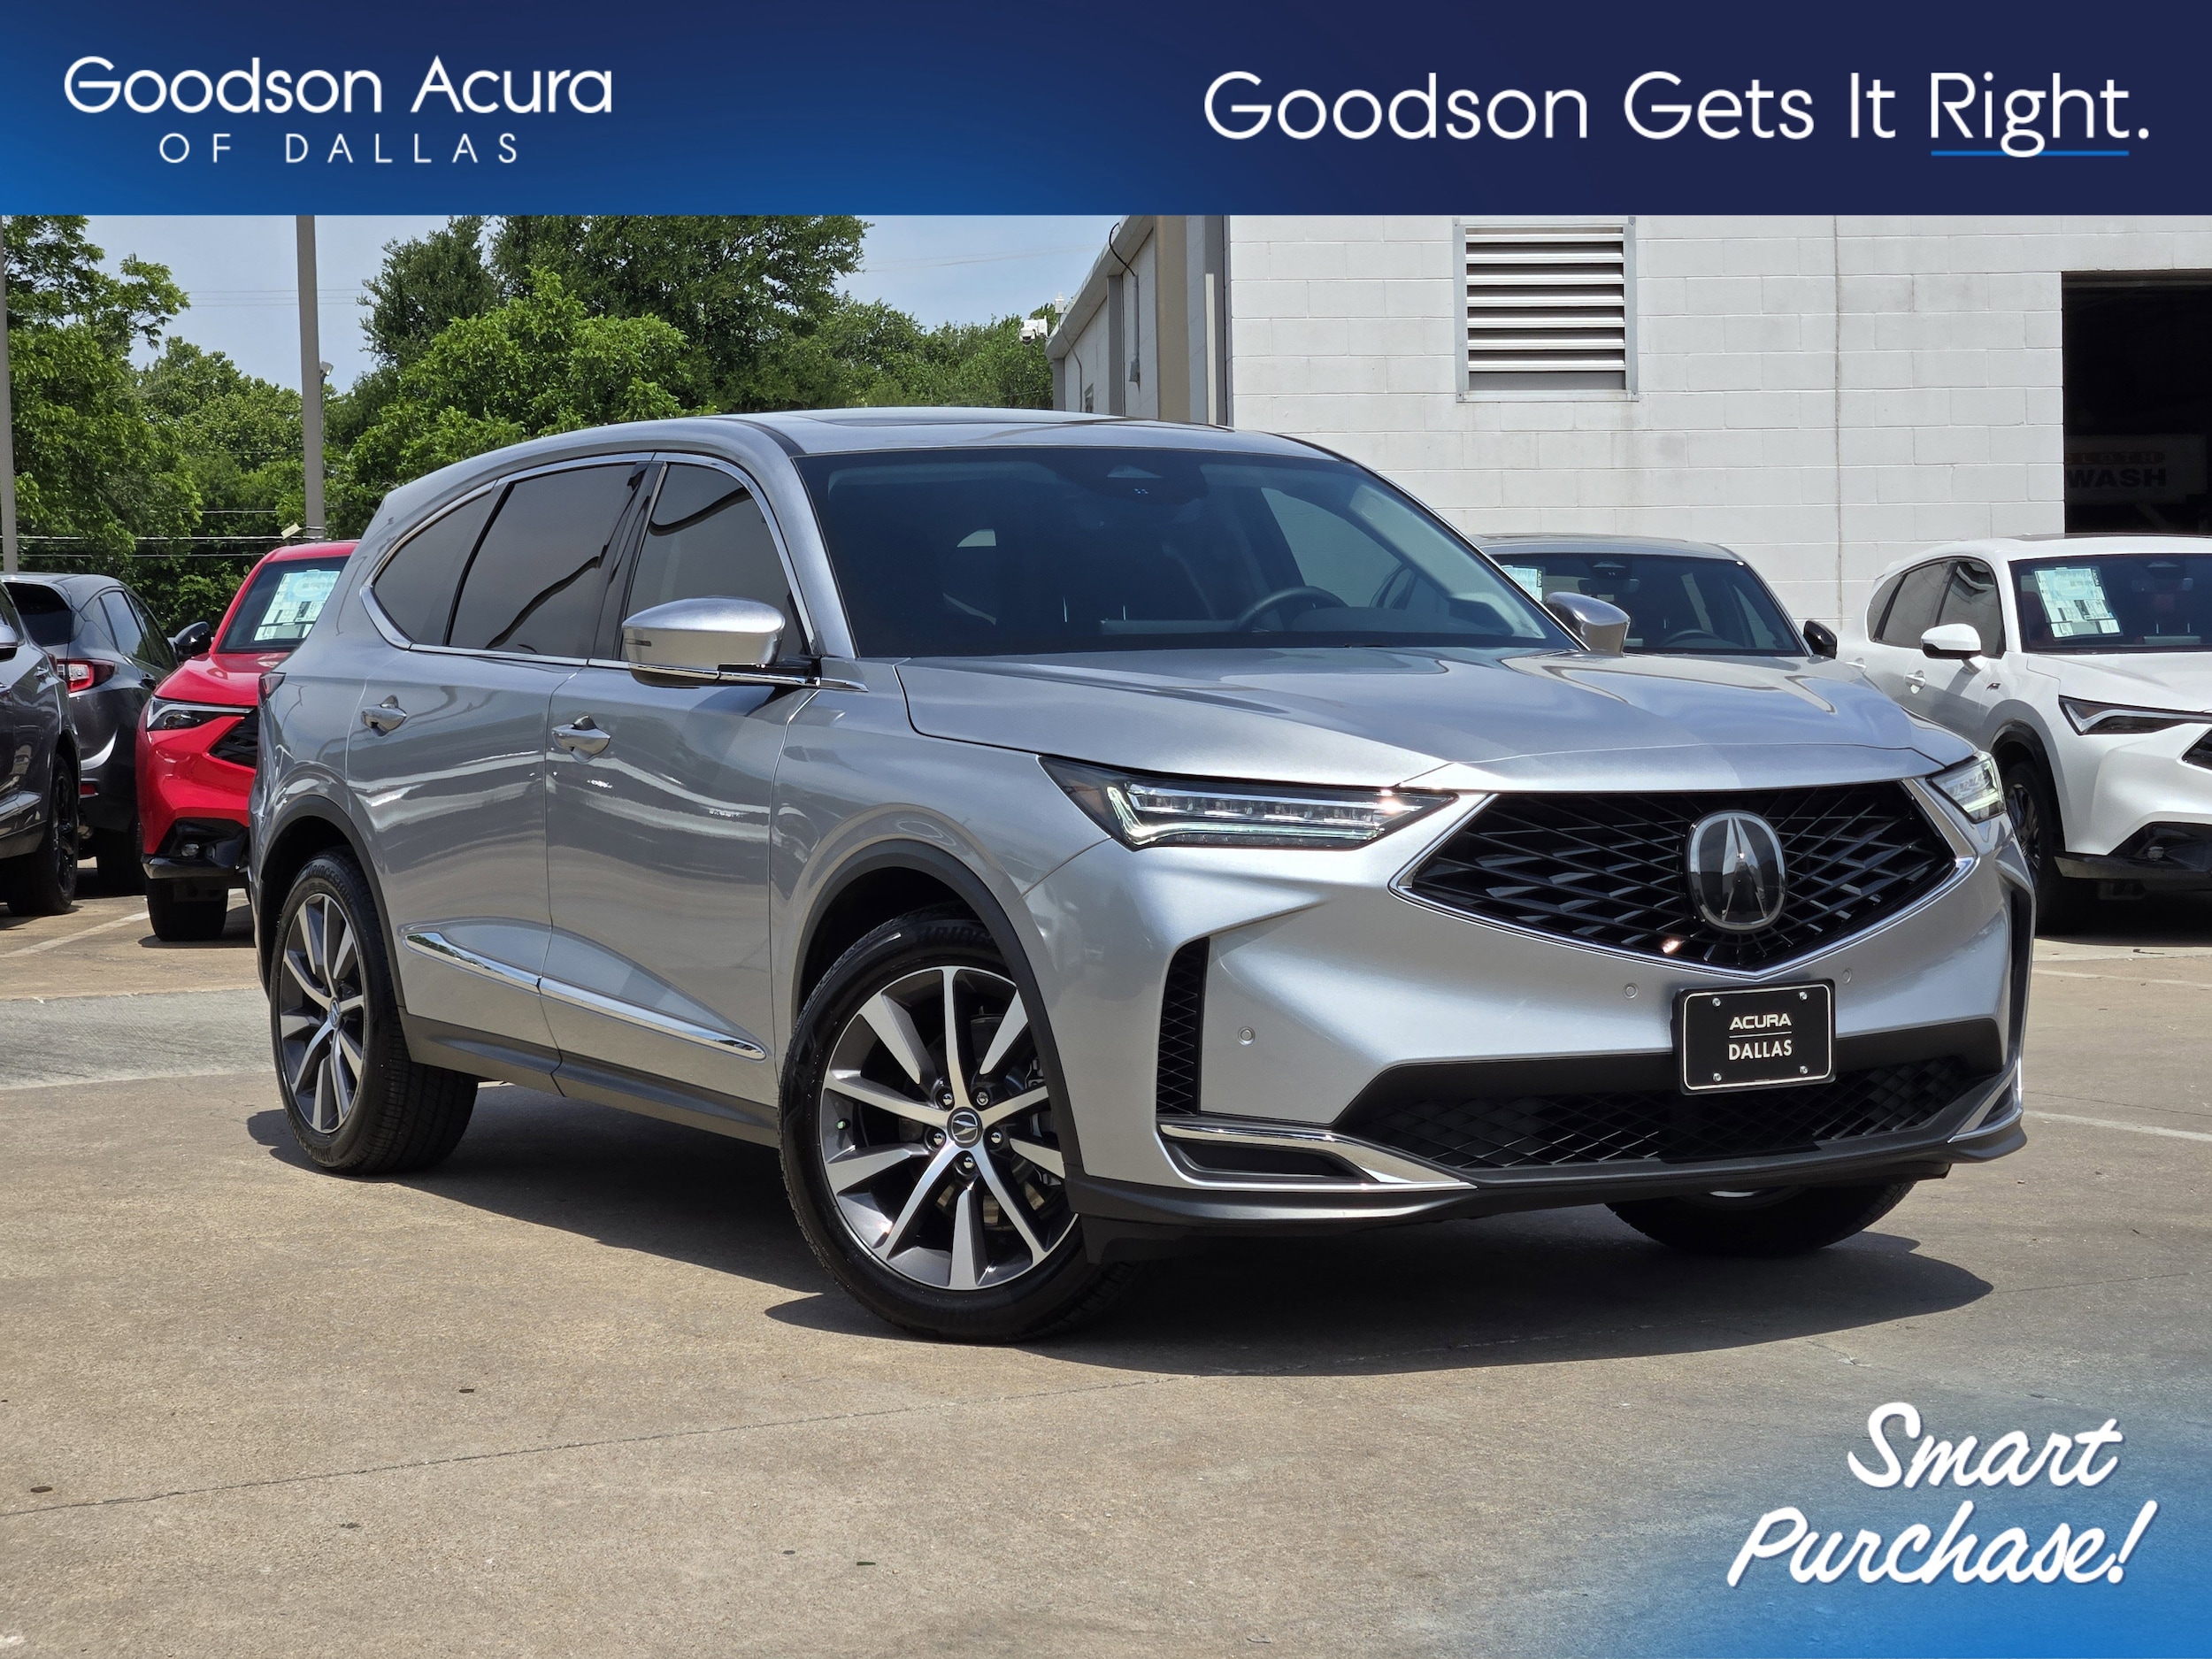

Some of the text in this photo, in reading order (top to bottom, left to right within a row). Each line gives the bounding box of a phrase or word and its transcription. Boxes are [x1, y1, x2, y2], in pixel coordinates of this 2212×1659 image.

[2067, 468, 2167, 488] WASH
[1729, 1013, 1792, 1031] ACURA
[1728, 1039, 1793, 1061] DALLAS
